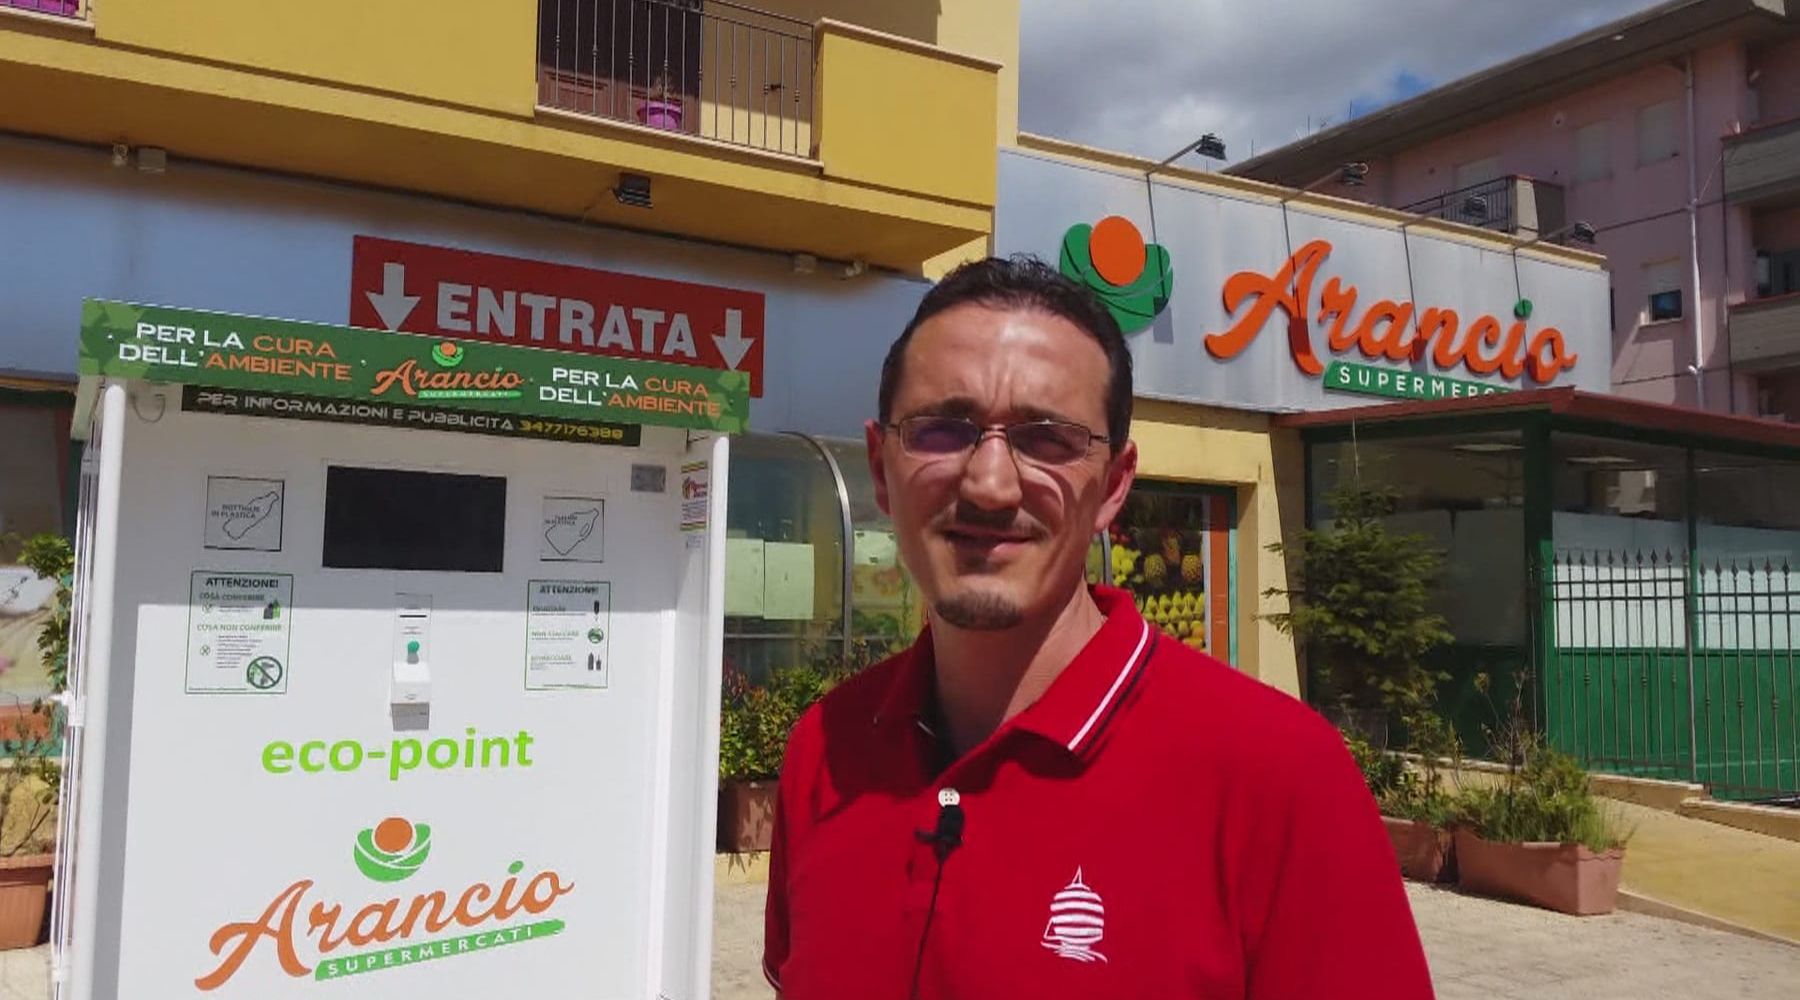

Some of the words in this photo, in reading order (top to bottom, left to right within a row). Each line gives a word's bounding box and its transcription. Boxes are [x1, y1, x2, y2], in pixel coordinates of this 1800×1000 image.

[437, 282, 697, 358] ENTRATA
[1204, 239, 1578, 383] Arancio
[136, 322, 196, 345] PER
[203, 329, 245, 350] LA
[252, 335, 338, 358] CURA
[118, 343, 352, 381] DELL'AMBIENTE
[370, 359, 525, 396] Arancio
[552, 367, 600, 387] PER
[605, 372, 639, 391] LA
[644, 377, 709, 398] CURA
[198, 391, 237, 407] PER
[244, 395, 388, 418] INFORMAZIONI
[393, 408, 404, 420] E
[539, 386, 722, 417] DELL'AMBIENTE
[205, 577, 279, 588] ATTENZIONE!
[197, 623, 219, 631] COSA
[261, 727, 534, 781] eco-point
[194, 860, 575, 991] Arancio
[327, 925, 535, 977] SUPERMERCATI
